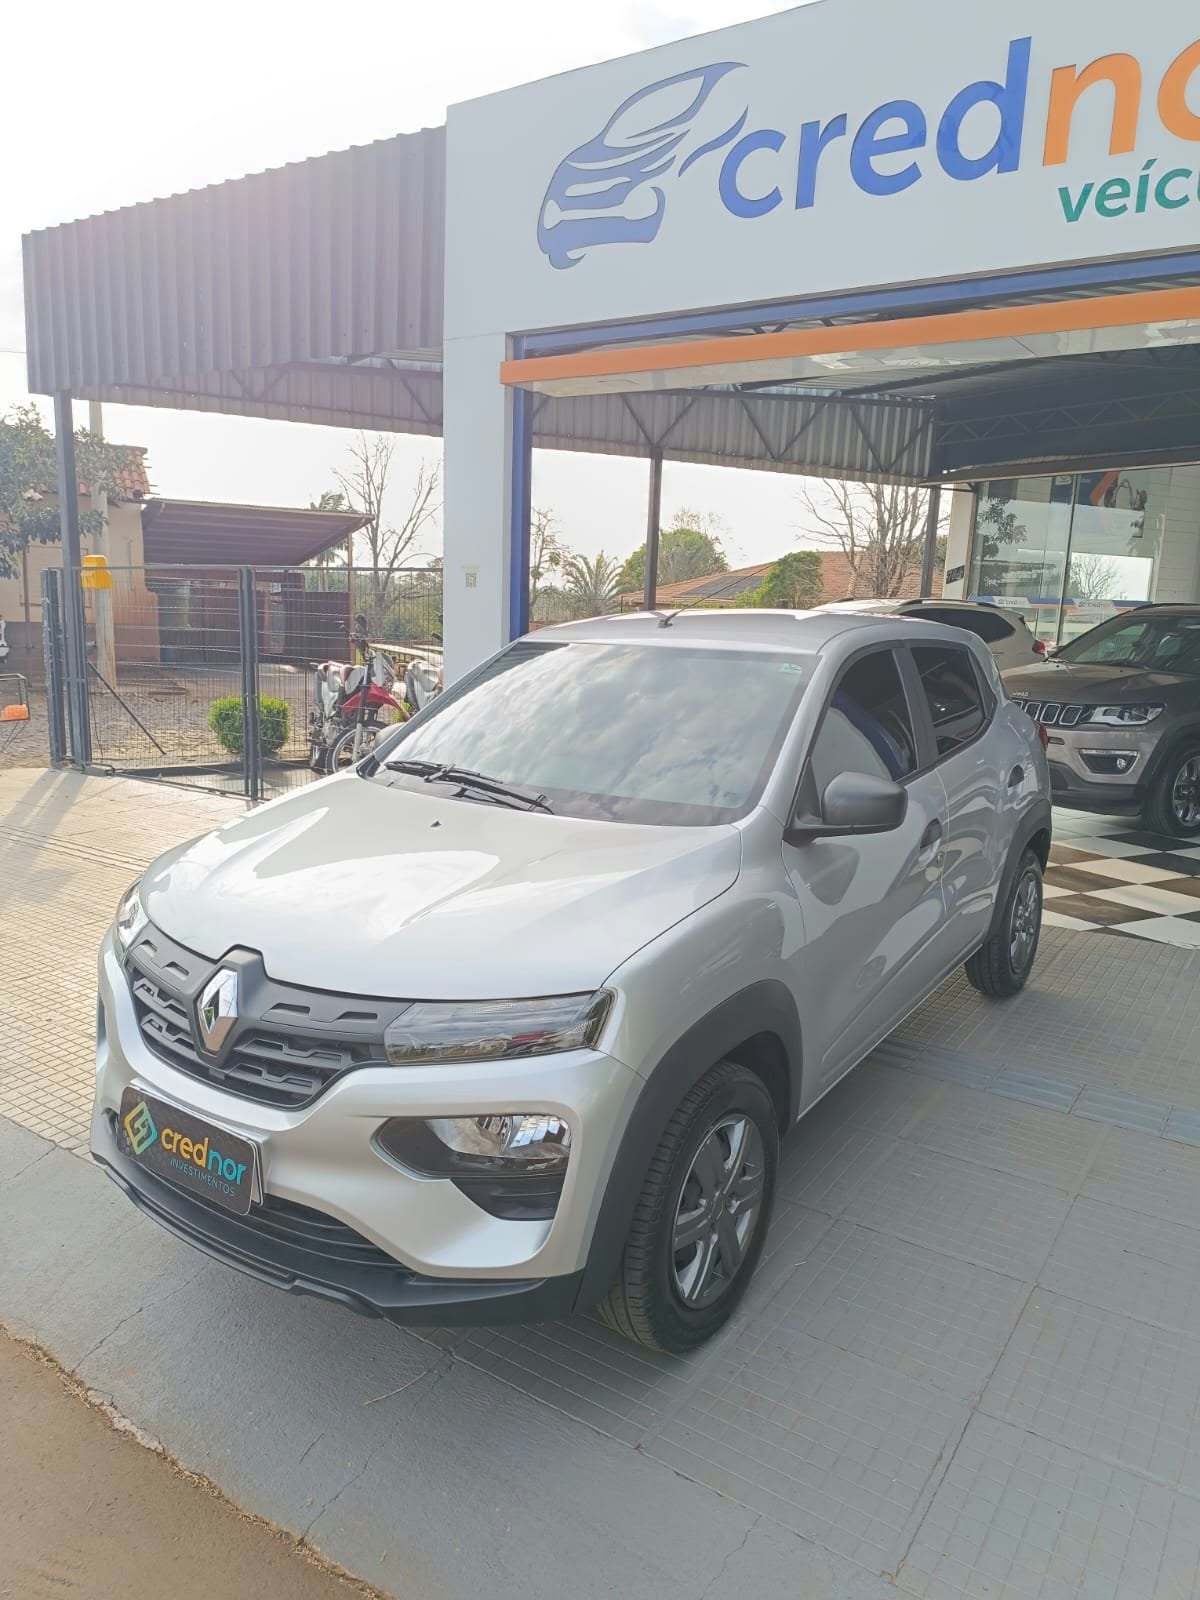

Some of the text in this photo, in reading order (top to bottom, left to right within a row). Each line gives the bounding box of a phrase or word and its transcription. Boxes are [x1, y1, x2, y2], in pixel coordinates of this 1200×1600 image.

[1058, 158, 1200, 223] veíc
[161, 1127, 247, 1185] crednor
[170, 1159, 235, 1196] INVESTIMENTOS
